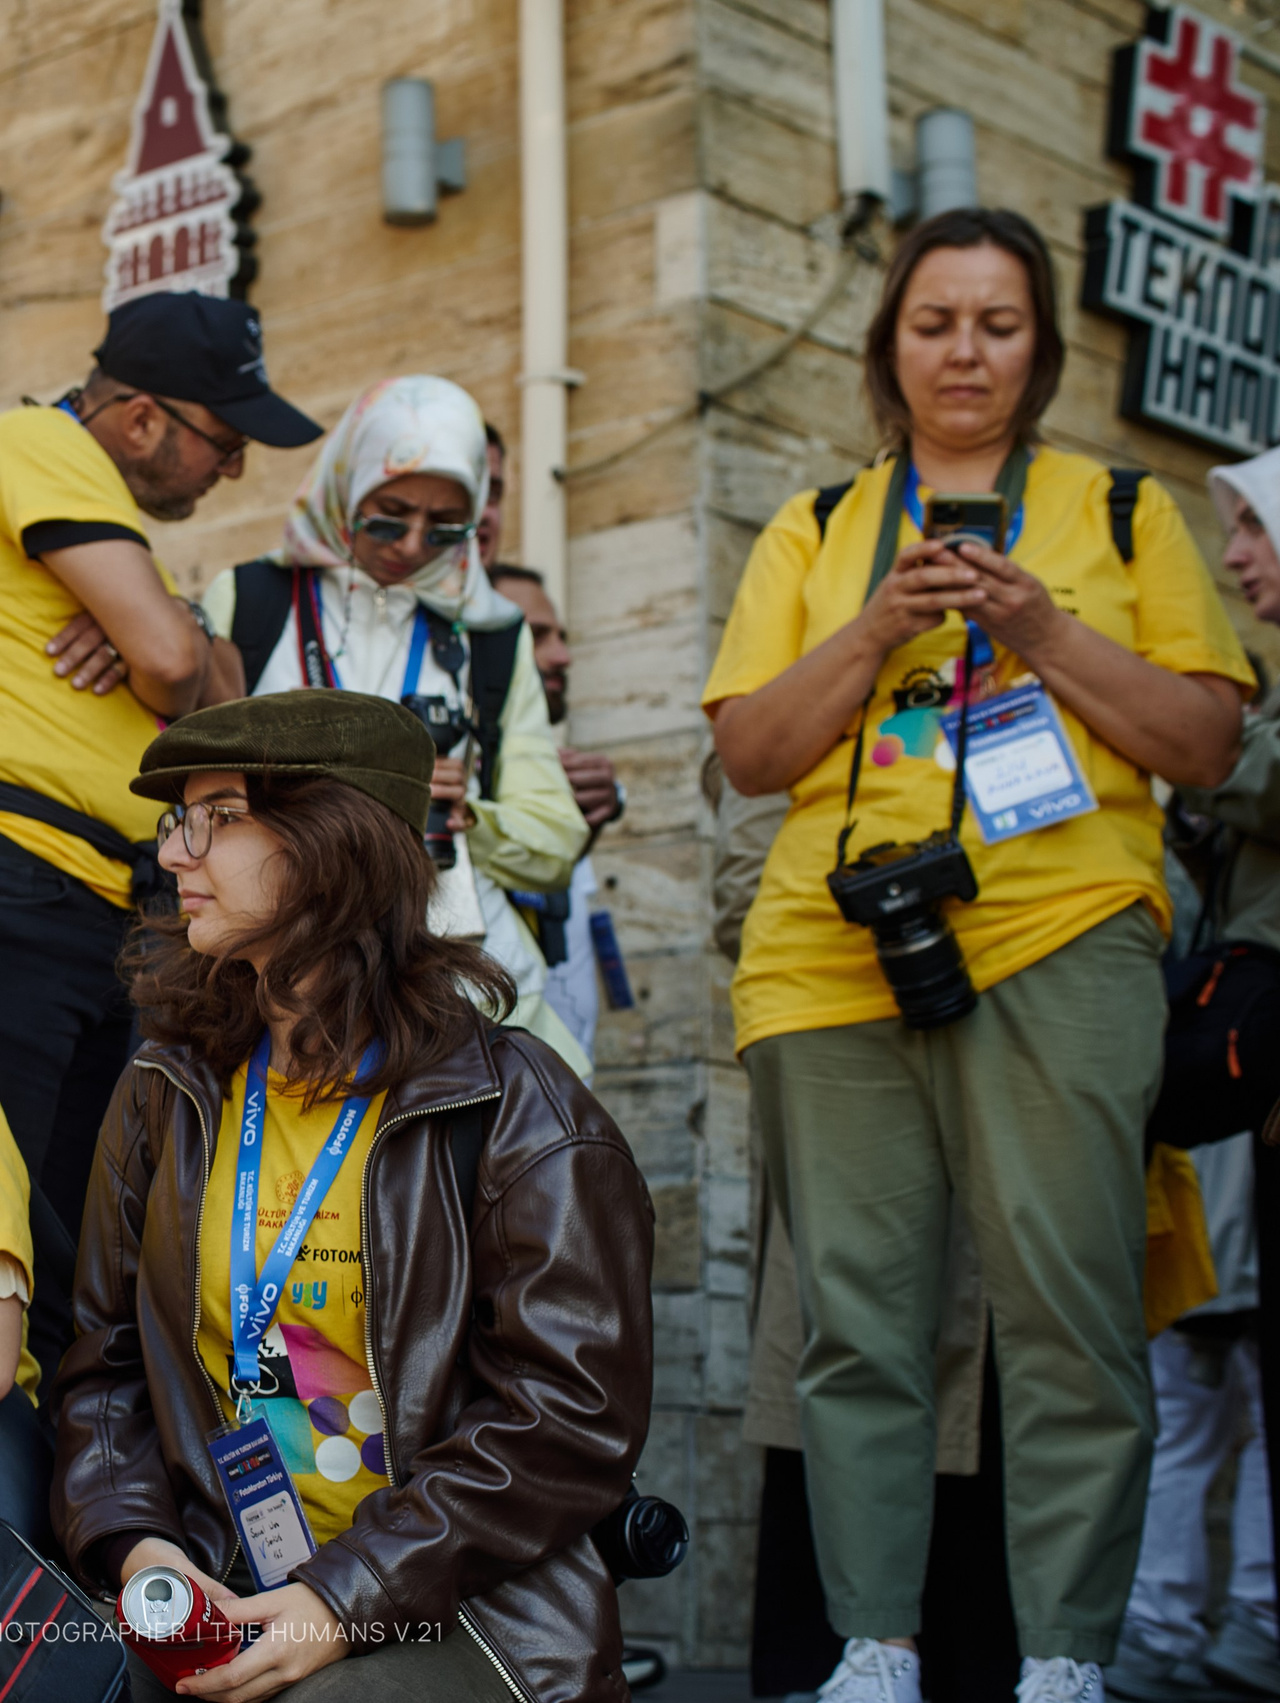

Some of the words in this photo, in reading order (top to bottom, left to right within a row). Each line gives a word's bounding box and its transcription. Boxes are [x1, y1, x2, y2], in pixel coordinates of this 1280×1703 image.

[1116, 212, 1280, 364] TEKNO
[244, 1091, 261, 1146] vivo
[333, 1108, 357, 1149] FOTON
[245, 1183, 254, 1210] KÜLTÜR
[301, 1179, 320, 1205] TURİZM
[244, 1210, 251, 1222] VE
[257, 1208, 286, 1219] ÜLTÜR
[314, 1209, 340, 1221] RİZM
[258, 1219, 287, 1229] BAKA
[297, 1203, 307, 1218] VE
[242, 1222, 251, 1252] TURİZM
[284, 1216, 301, 1243] KÜLTÜR
[285, 1218, 308, 1257] BAKANLIĞI
[277, 1242, 287, 1254] T.C.
[247, 1283, 278, 1339] vivo
